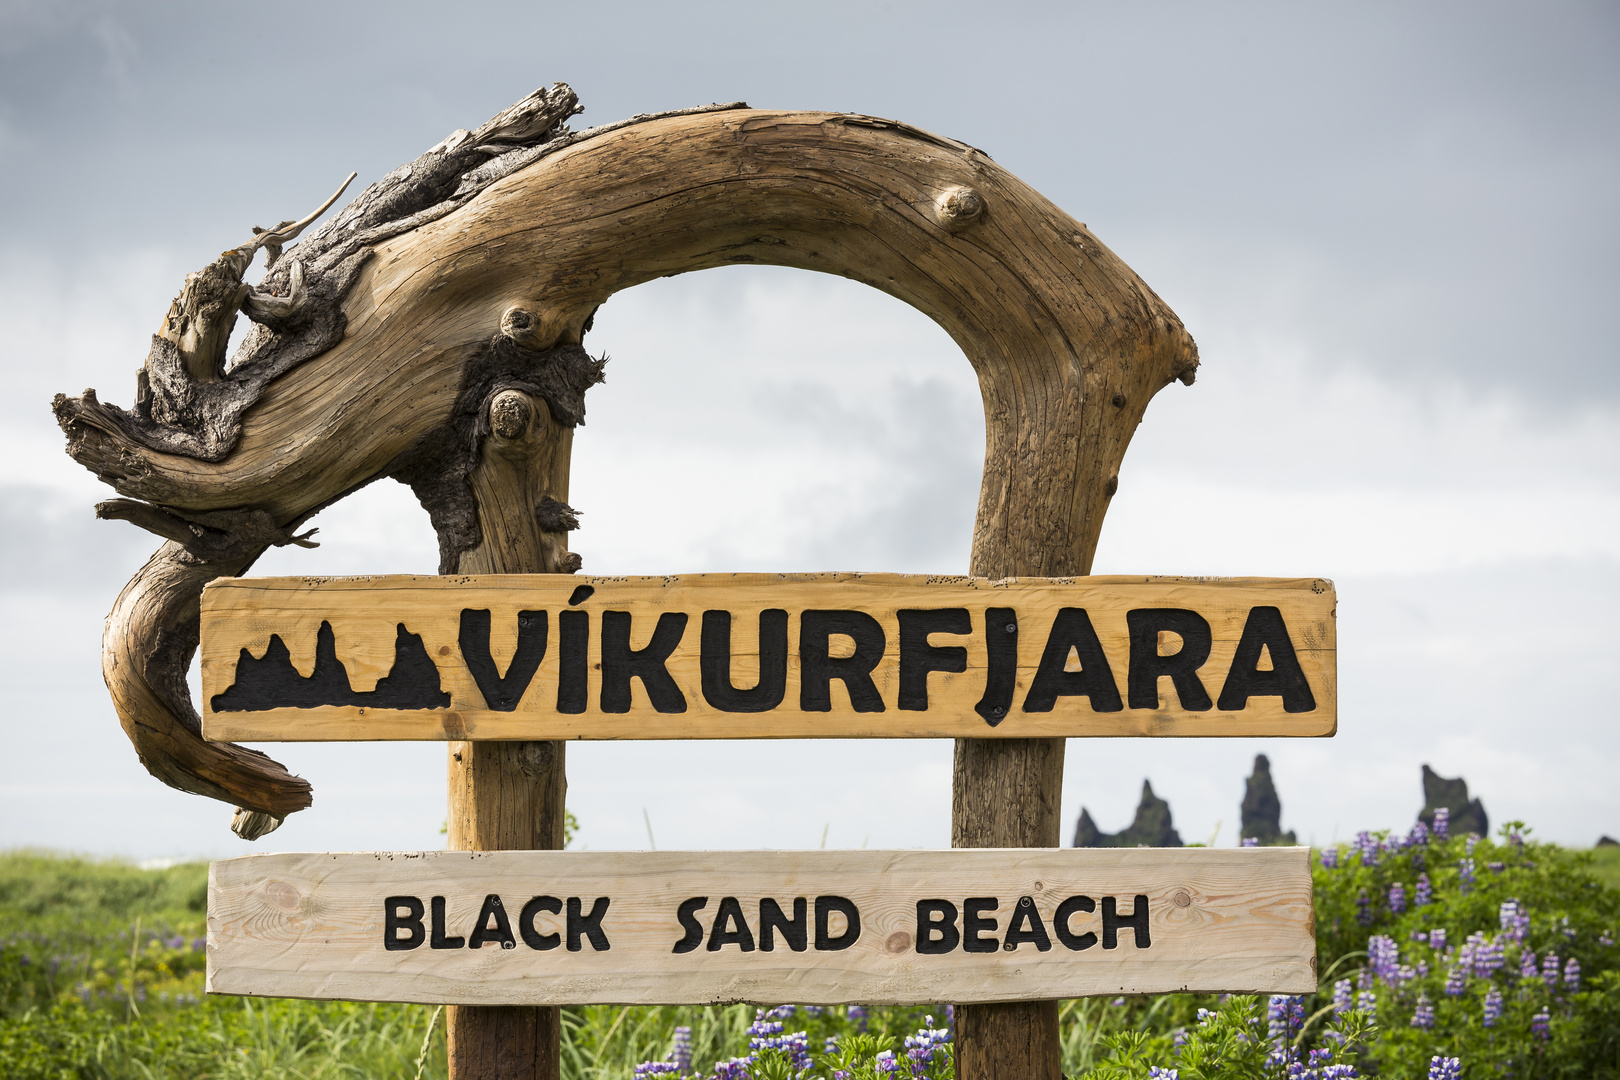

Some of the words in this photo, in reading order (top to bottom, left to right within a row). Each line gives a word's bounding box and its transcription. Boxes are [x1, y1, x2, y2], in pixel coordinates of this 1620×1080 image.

[458, 585, 1317, 728] VÍKURFJARA
[384, 894, 611, 953] BLACK
[672, 896, 861, 954] SAND
[916, 894, 1152, 955] BEACH
